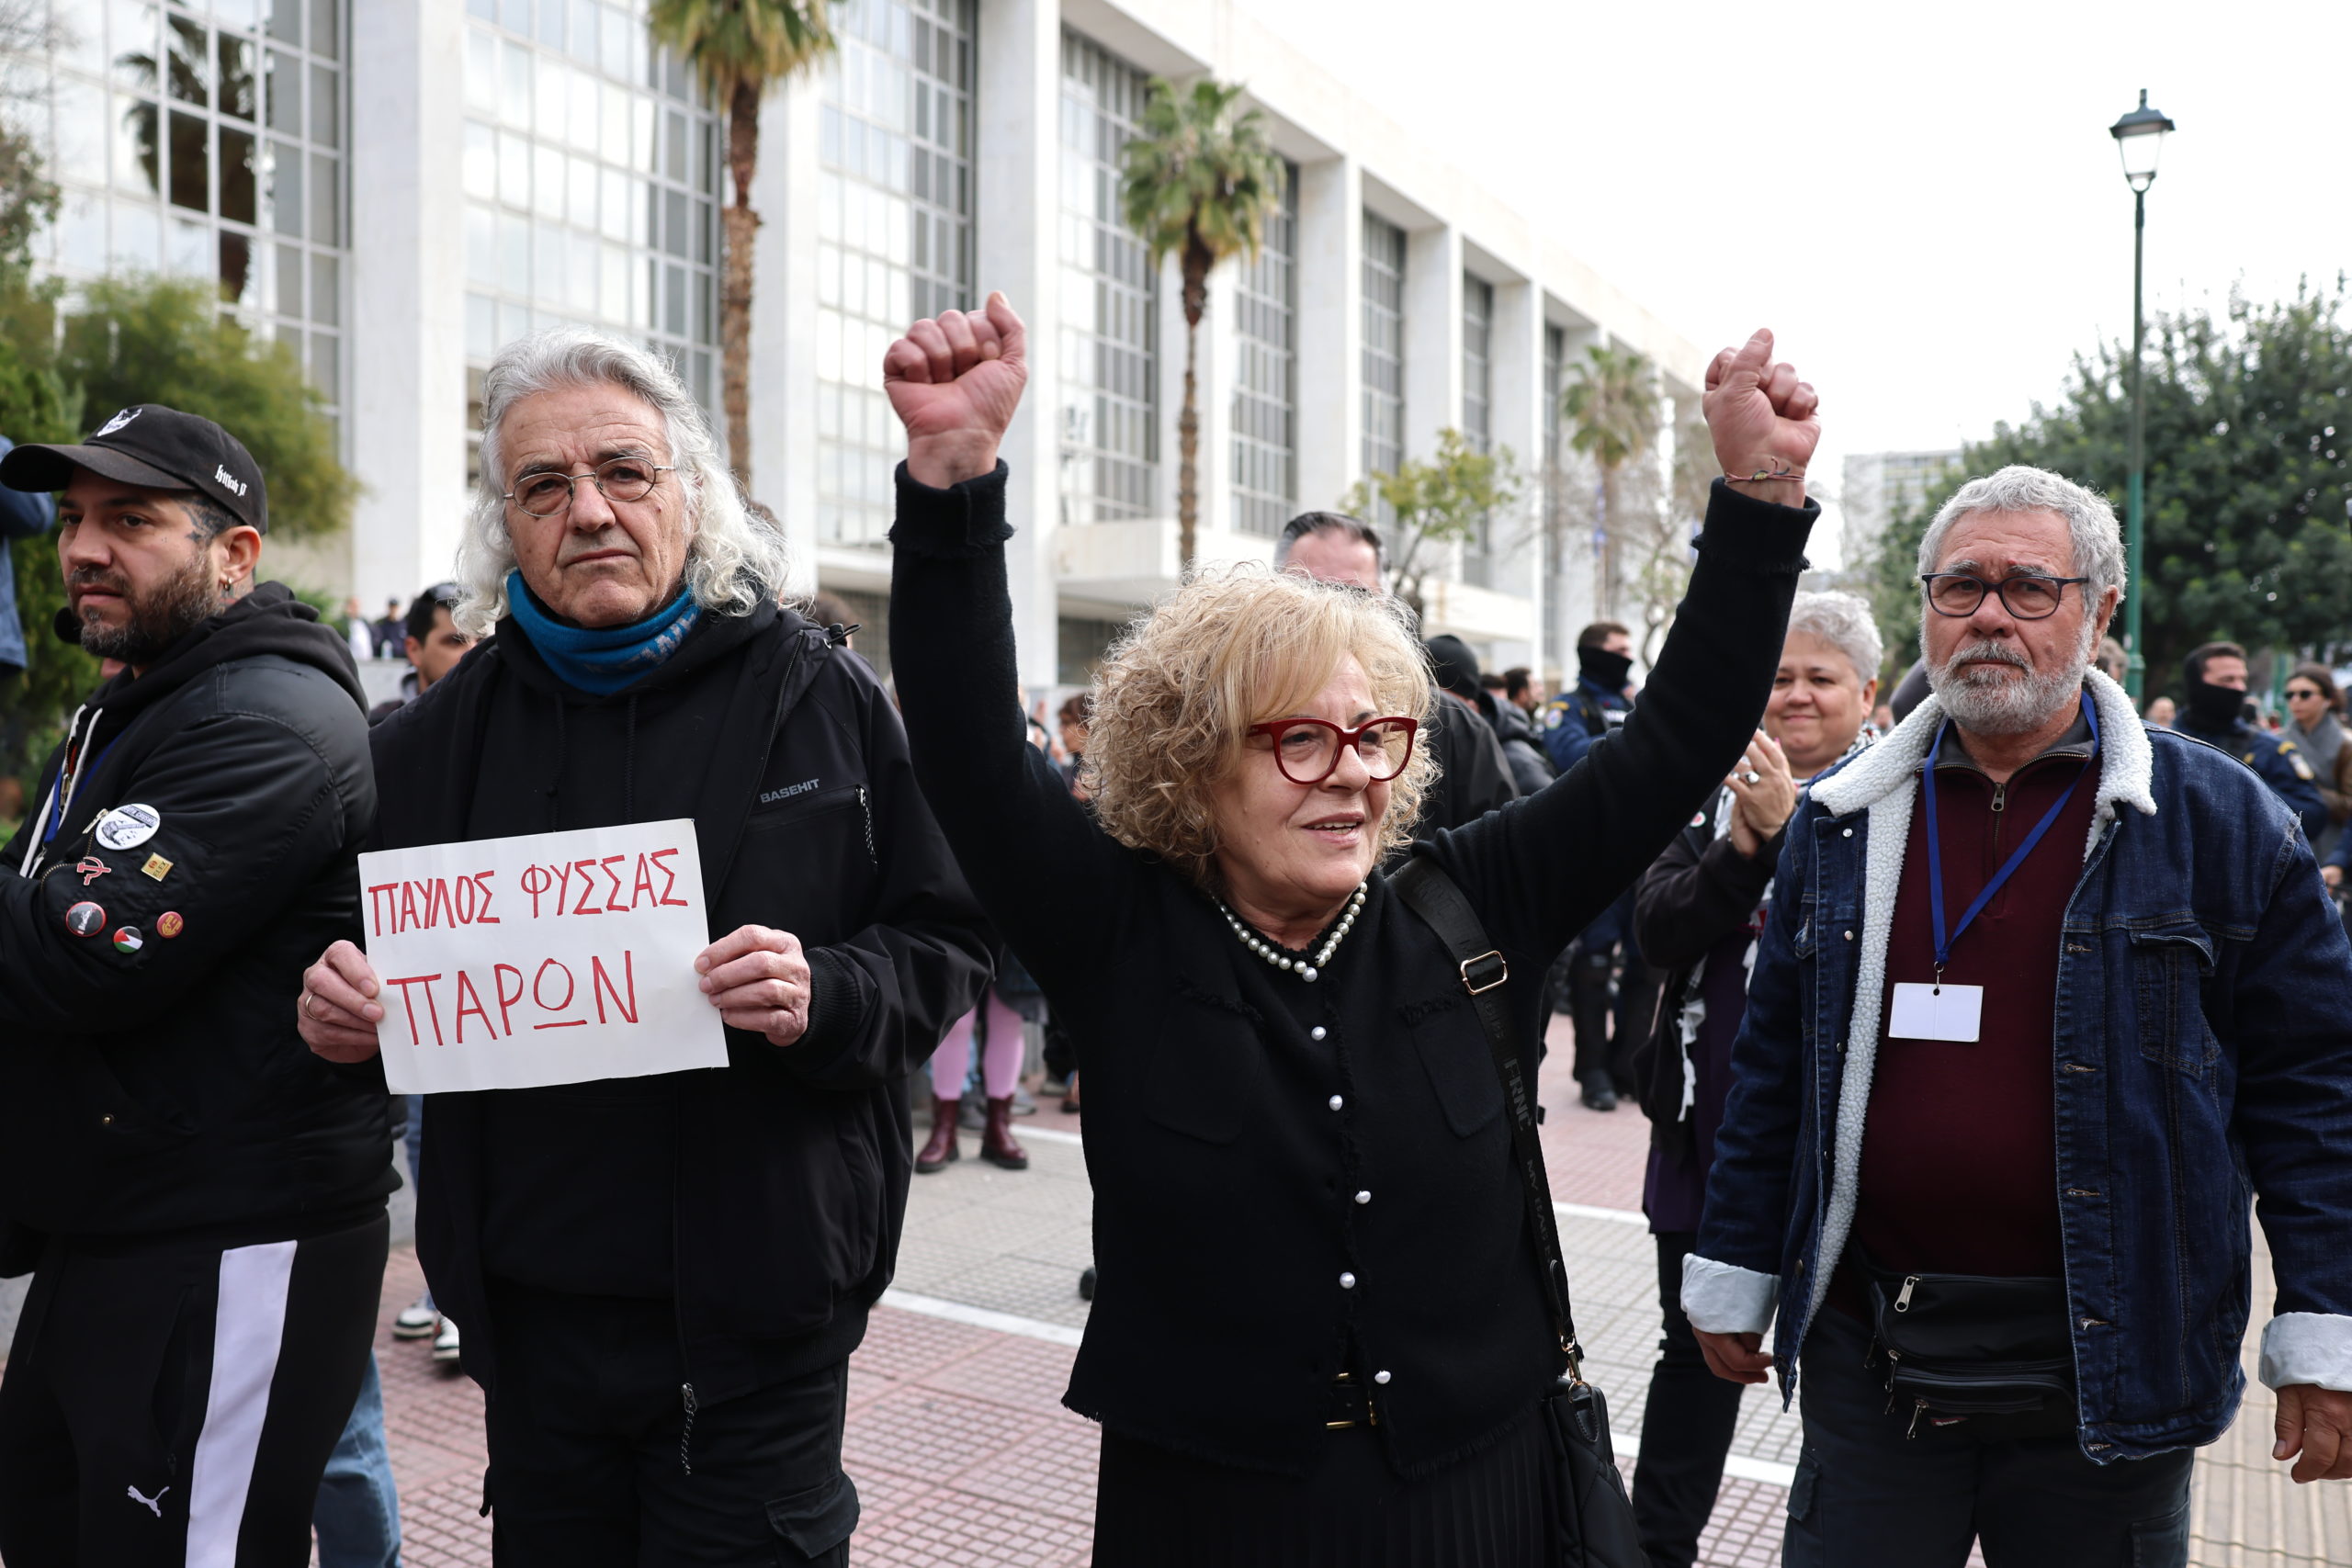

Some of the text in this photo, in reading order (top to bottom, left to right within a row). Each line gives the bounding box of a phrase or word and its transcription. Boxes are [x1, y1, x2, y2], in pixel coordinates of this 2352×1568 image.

[760, 778, 820, 804] BASEHIT
[368, 848, 688, 937] ΠΑΥΛΟΣ ΦΥΣΣΑΣ
[386, 950, 639, 1046] ΠΑΡΩΝ
[1504, 1057, 1532, 1132] FRNC
